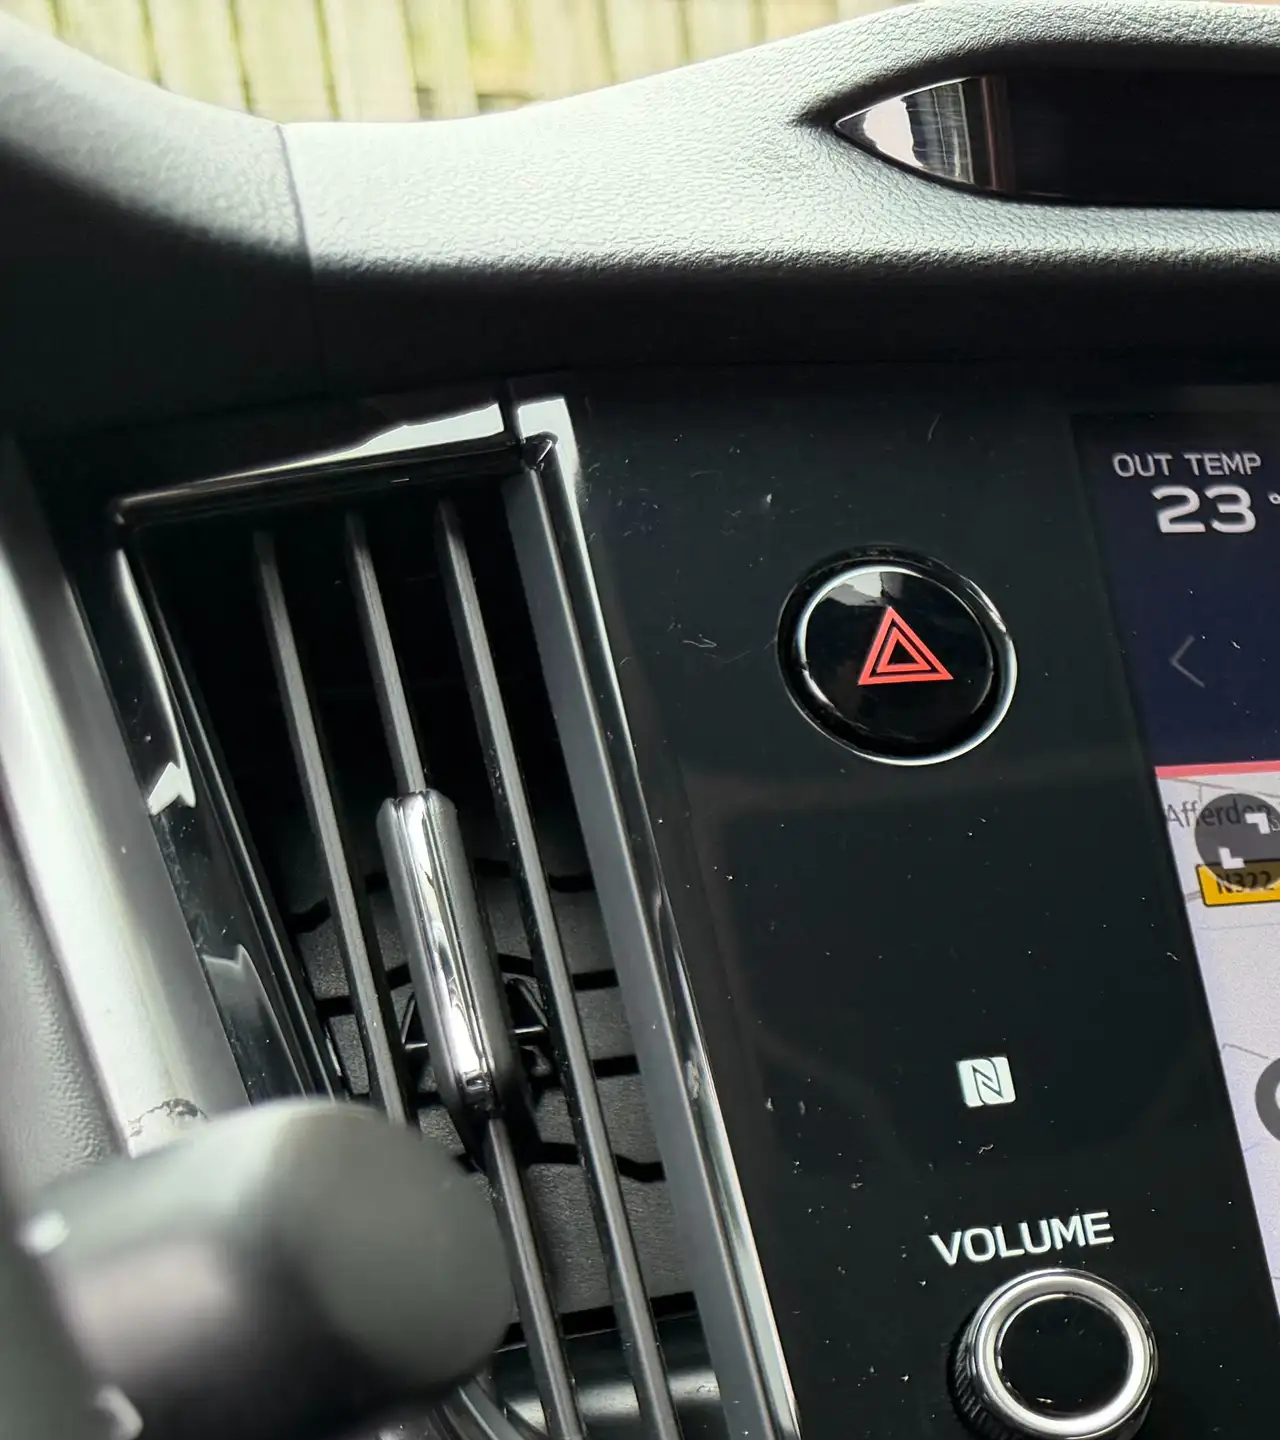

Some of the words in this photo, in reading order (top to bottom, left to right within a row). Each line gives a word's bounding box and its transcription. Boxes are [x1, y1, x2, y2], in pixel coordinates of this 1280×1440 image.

[1112, 453, 1172, 478] OUT
[1184, 451, 1262, 476] TEMP
[1150, 485, 1258, 534] 23
[929, 1210, 1115, 1267] VOLUME
